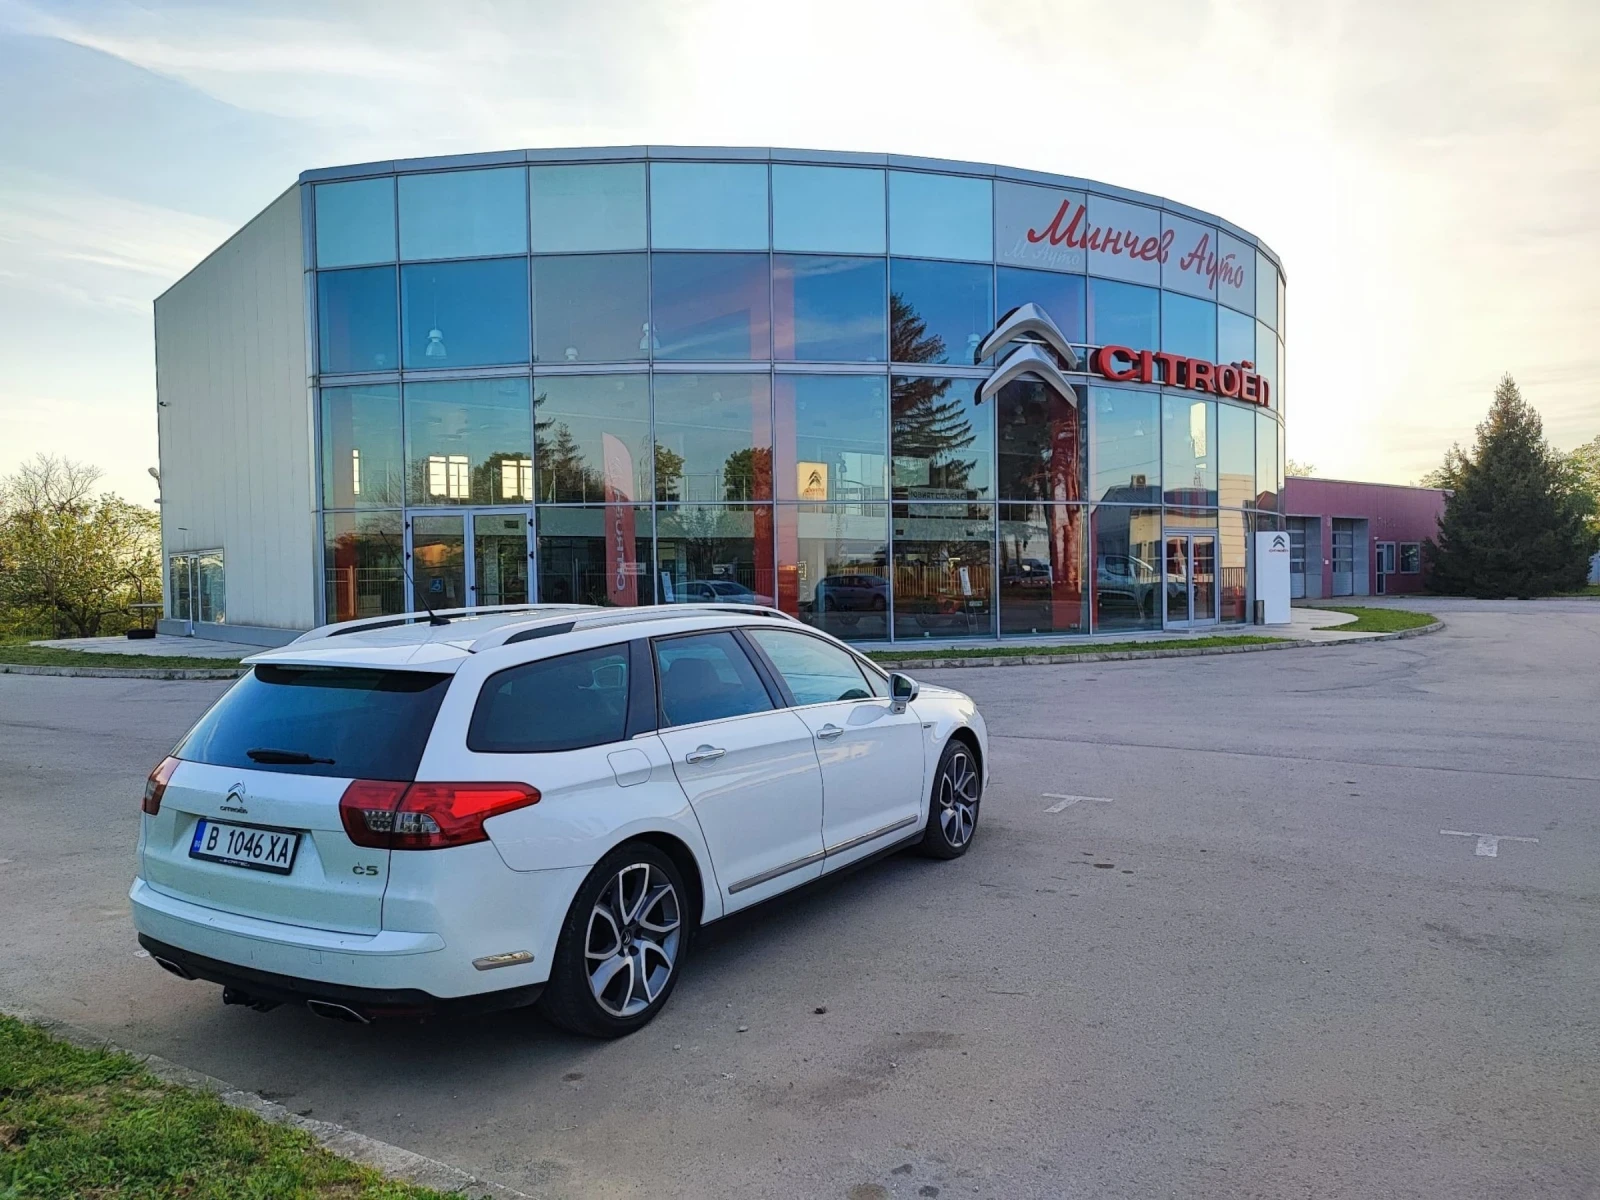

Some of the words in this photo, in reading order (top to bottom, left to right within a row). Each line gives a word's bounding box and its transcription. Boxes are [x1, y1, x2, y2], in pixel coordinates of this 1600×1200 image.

[1027, 199, 1175, 264] Минчев
[1179, 232, 1244, 290] Ауто
[206, 826, 220, 851] B
[227, 829, 265, 859] 1046
[265, 835, 289, 864] XA
[352, 865, 379, 876] C5
